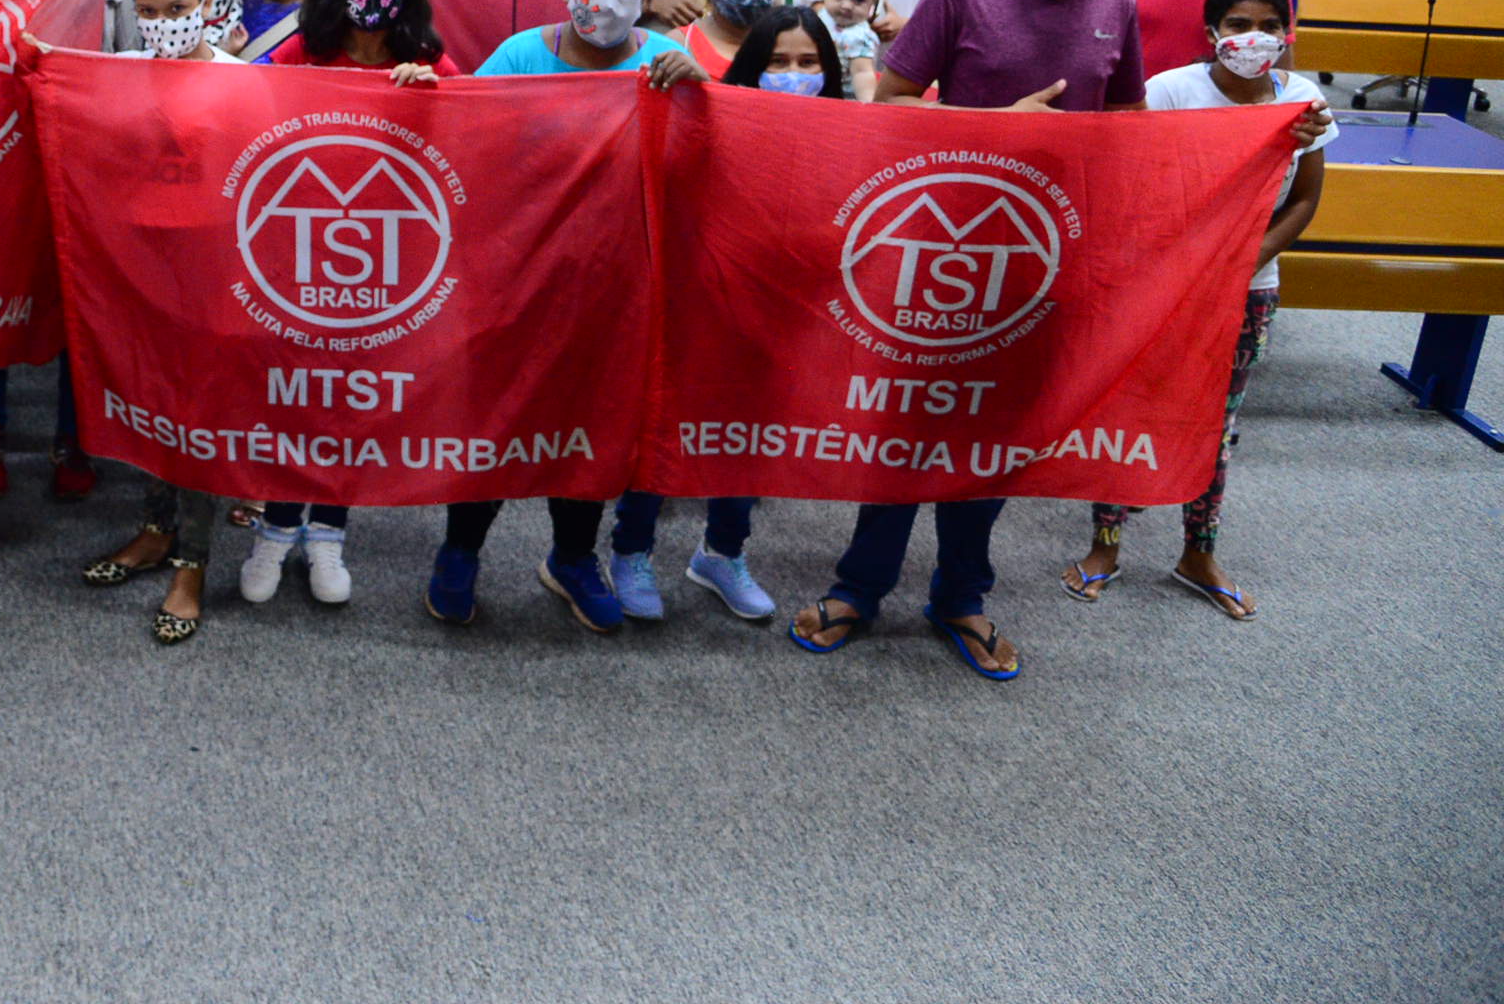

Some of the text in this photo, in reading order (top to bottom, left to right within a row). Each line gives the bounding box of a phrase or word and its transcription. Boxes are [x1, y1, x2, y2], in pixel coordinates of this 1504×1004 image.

[222, 132, 274, 200] MOVIMENTO
[273, 117, 303, 139] DOS
[303, 111, 425, 149] TRABALHADORES
[422, 144, 451, 173] SEM
[444, 164, 469, 206] TETO
[833, 149, 1083, 241] MOVIMENTO DOS TRABALHADORES SEM TETO
[229, 275, 460, 353] NA LUTA PELA REFORMA URBANA
[299, 285, 396, 310] BRASIL
[894, 308, 991, 332] BRASIL
[826, 298, 1058, 367] NA LUTA PELA REFORMA URBANA
[267, 367, 415, 413] MTST
[845, 374, 997, 416] MTST
[103, 389, 596, 473] RESISTÊNCIA URBANA
[679, 421, 956, 475] RESISTÊNCIA
